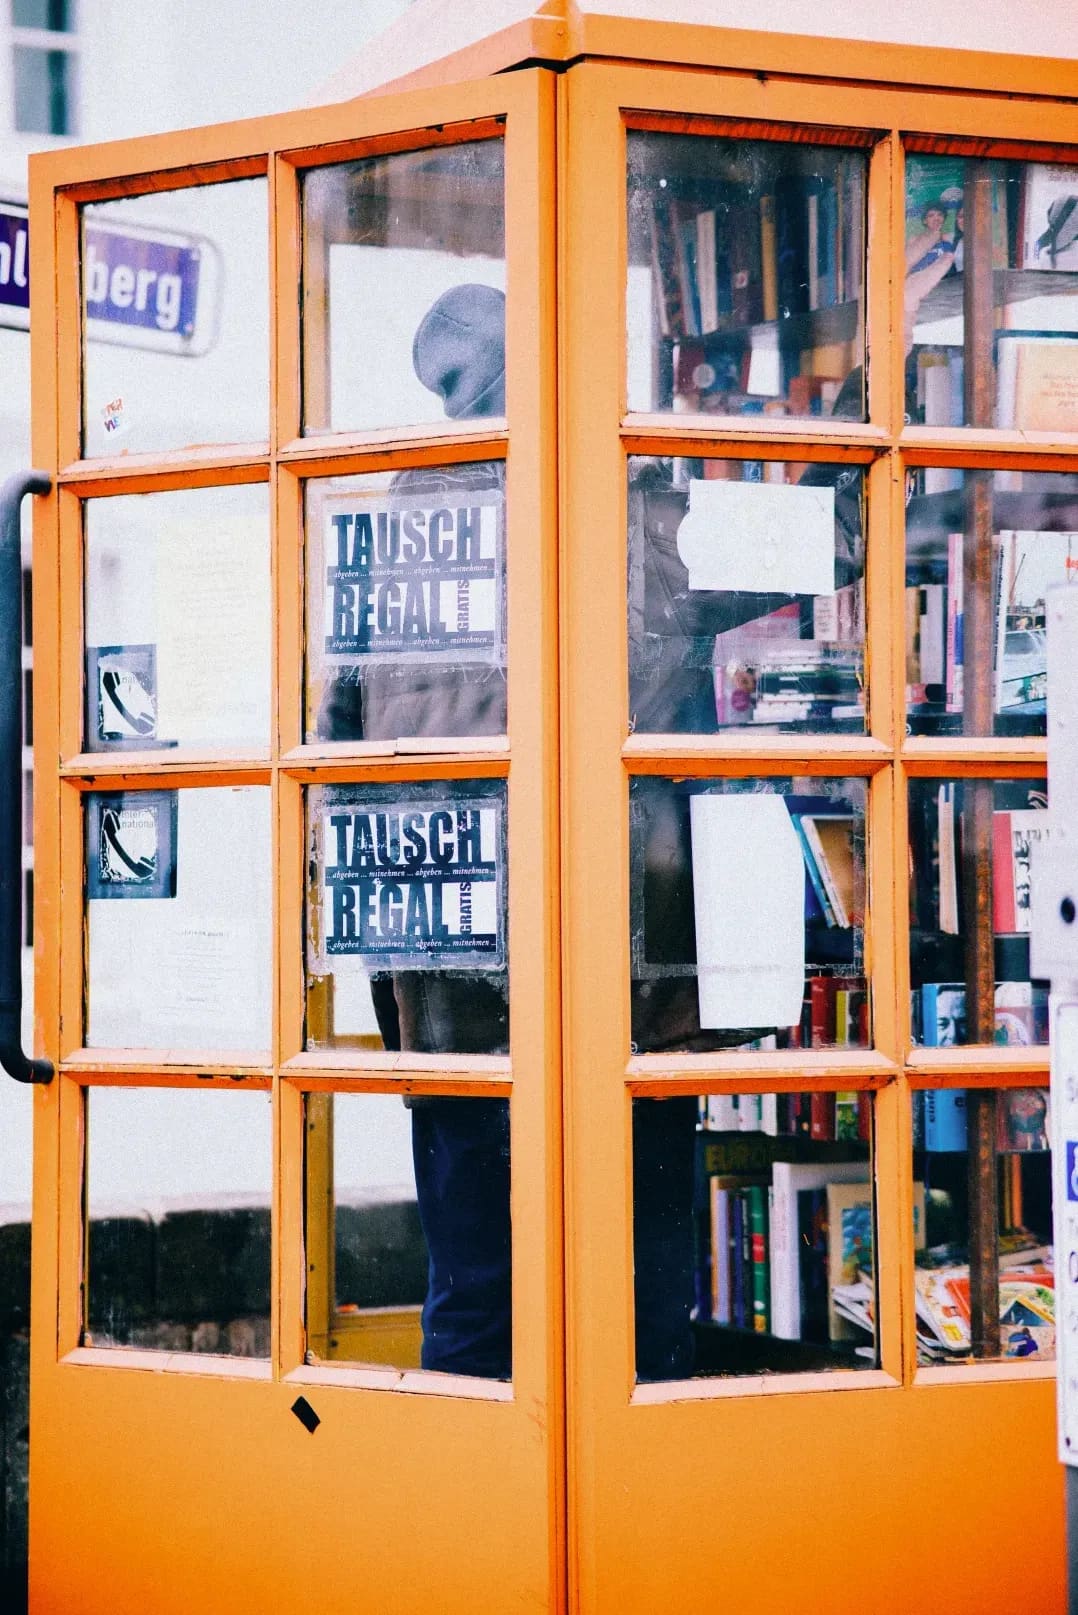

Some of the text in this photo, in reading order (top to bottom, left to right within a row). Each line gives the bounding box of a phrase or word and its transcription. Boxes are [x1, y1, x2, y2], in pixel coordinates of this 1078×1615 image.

[87, 245, 182, 330] berg
[332, 507, 482, 566] TAUSCH
[332, 580, 447, 637] REGAL
[457, 580, 470, 632] GRATIS
[331, 810, 482, 867] TAUSCH
[332, 866, 489, 880] abgeben mitnehmen abgeben mitnehmen
[332, 882, 449, 937] REGAL
[459, 881, 472, 934] GRATIS
[333, 940, 359, 950] abgeben
[415, 939, 442, 949] abgeben
[452, 938, 490, 947] mitnehmen
